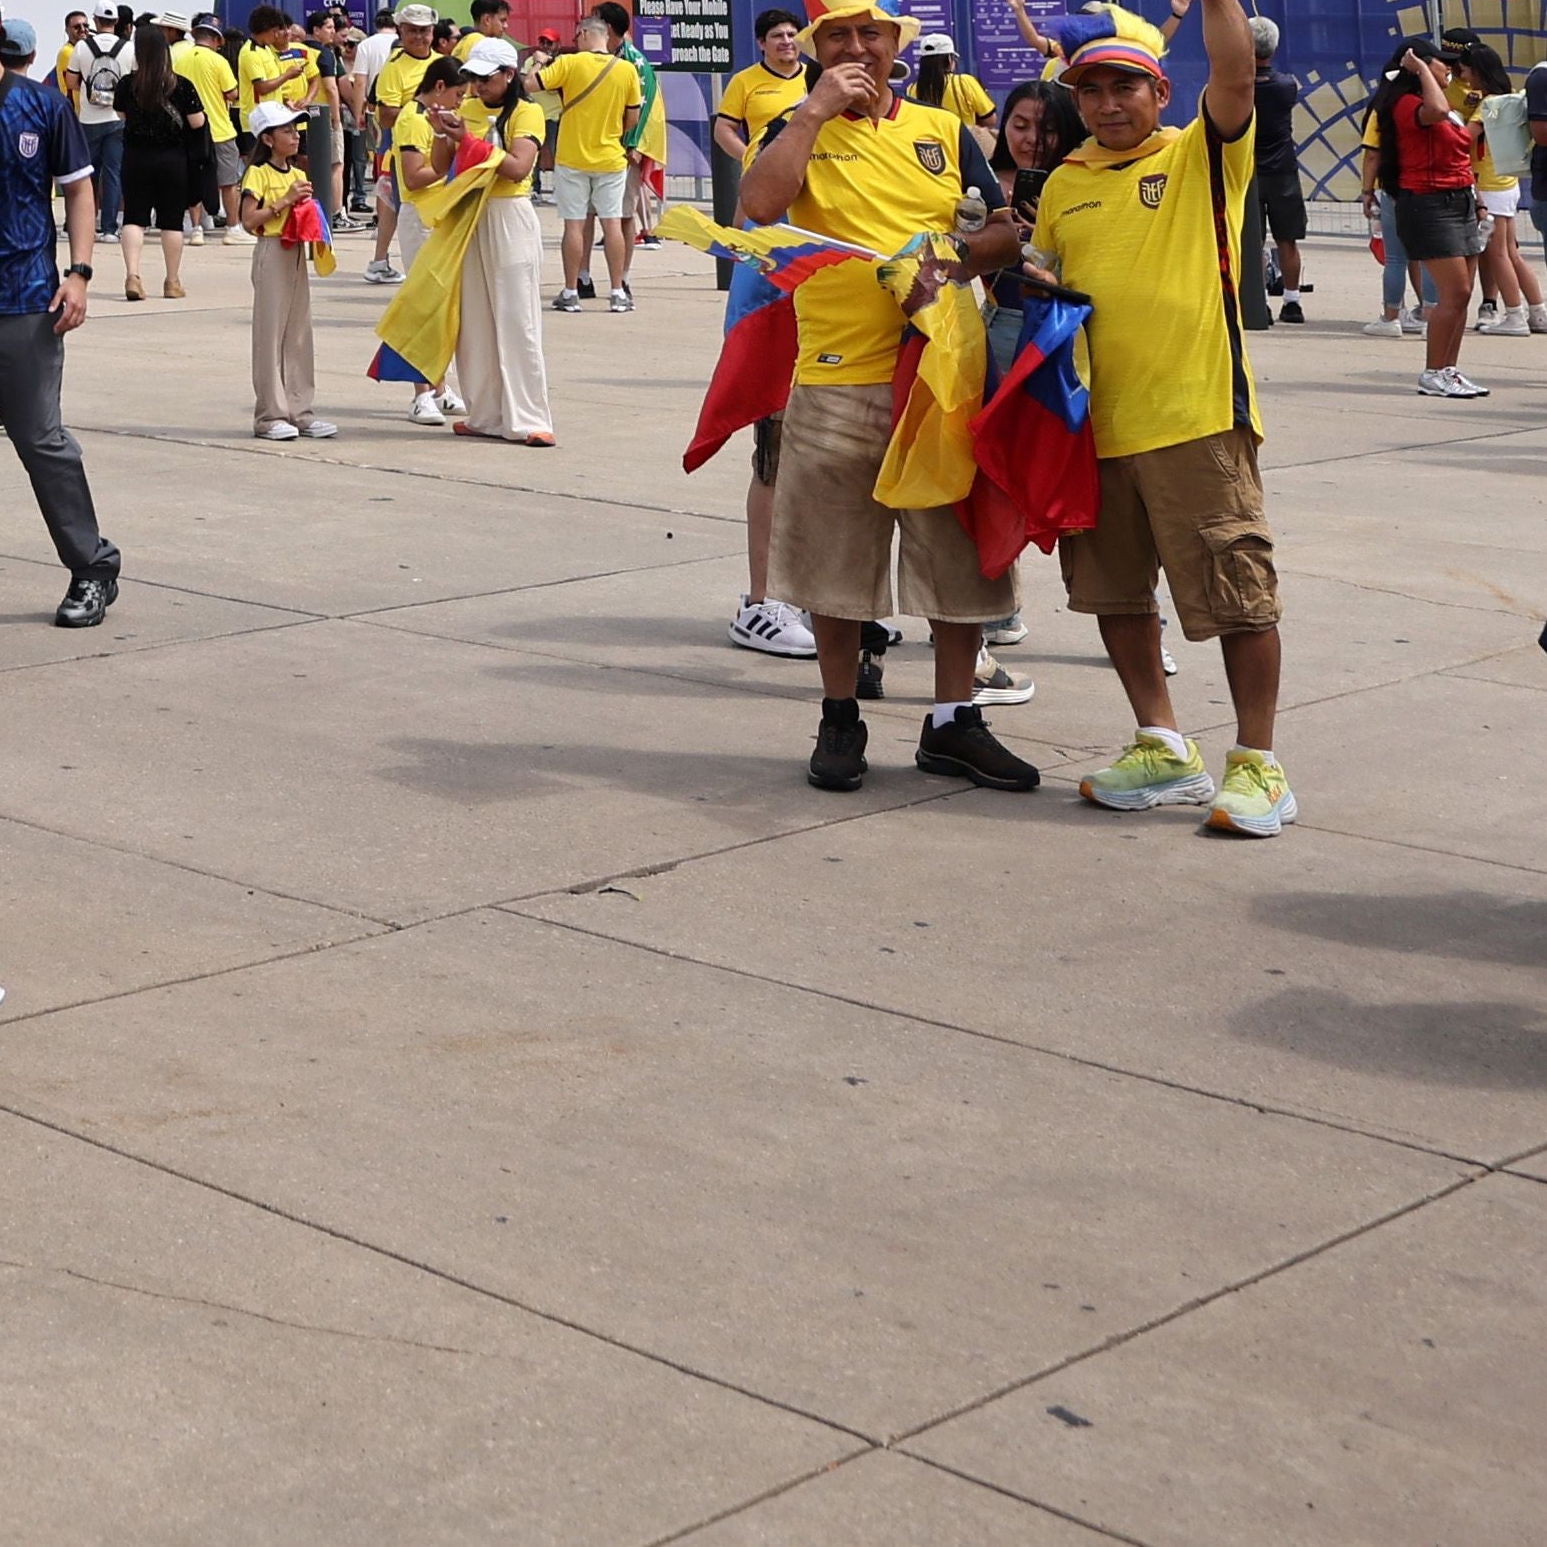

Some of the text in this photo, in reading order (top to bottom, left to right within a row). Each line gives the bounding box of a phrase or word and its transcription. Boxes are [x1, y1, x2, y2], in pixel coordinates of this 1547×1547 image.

[640, 0, 728, 15] Please Have Your Mobile
[680, 22, 703, 40] Ready
[704, 24, 714, 39] as
[714, 22, 729, 39] You
[672, 45, 730, 64] proach the Gate
